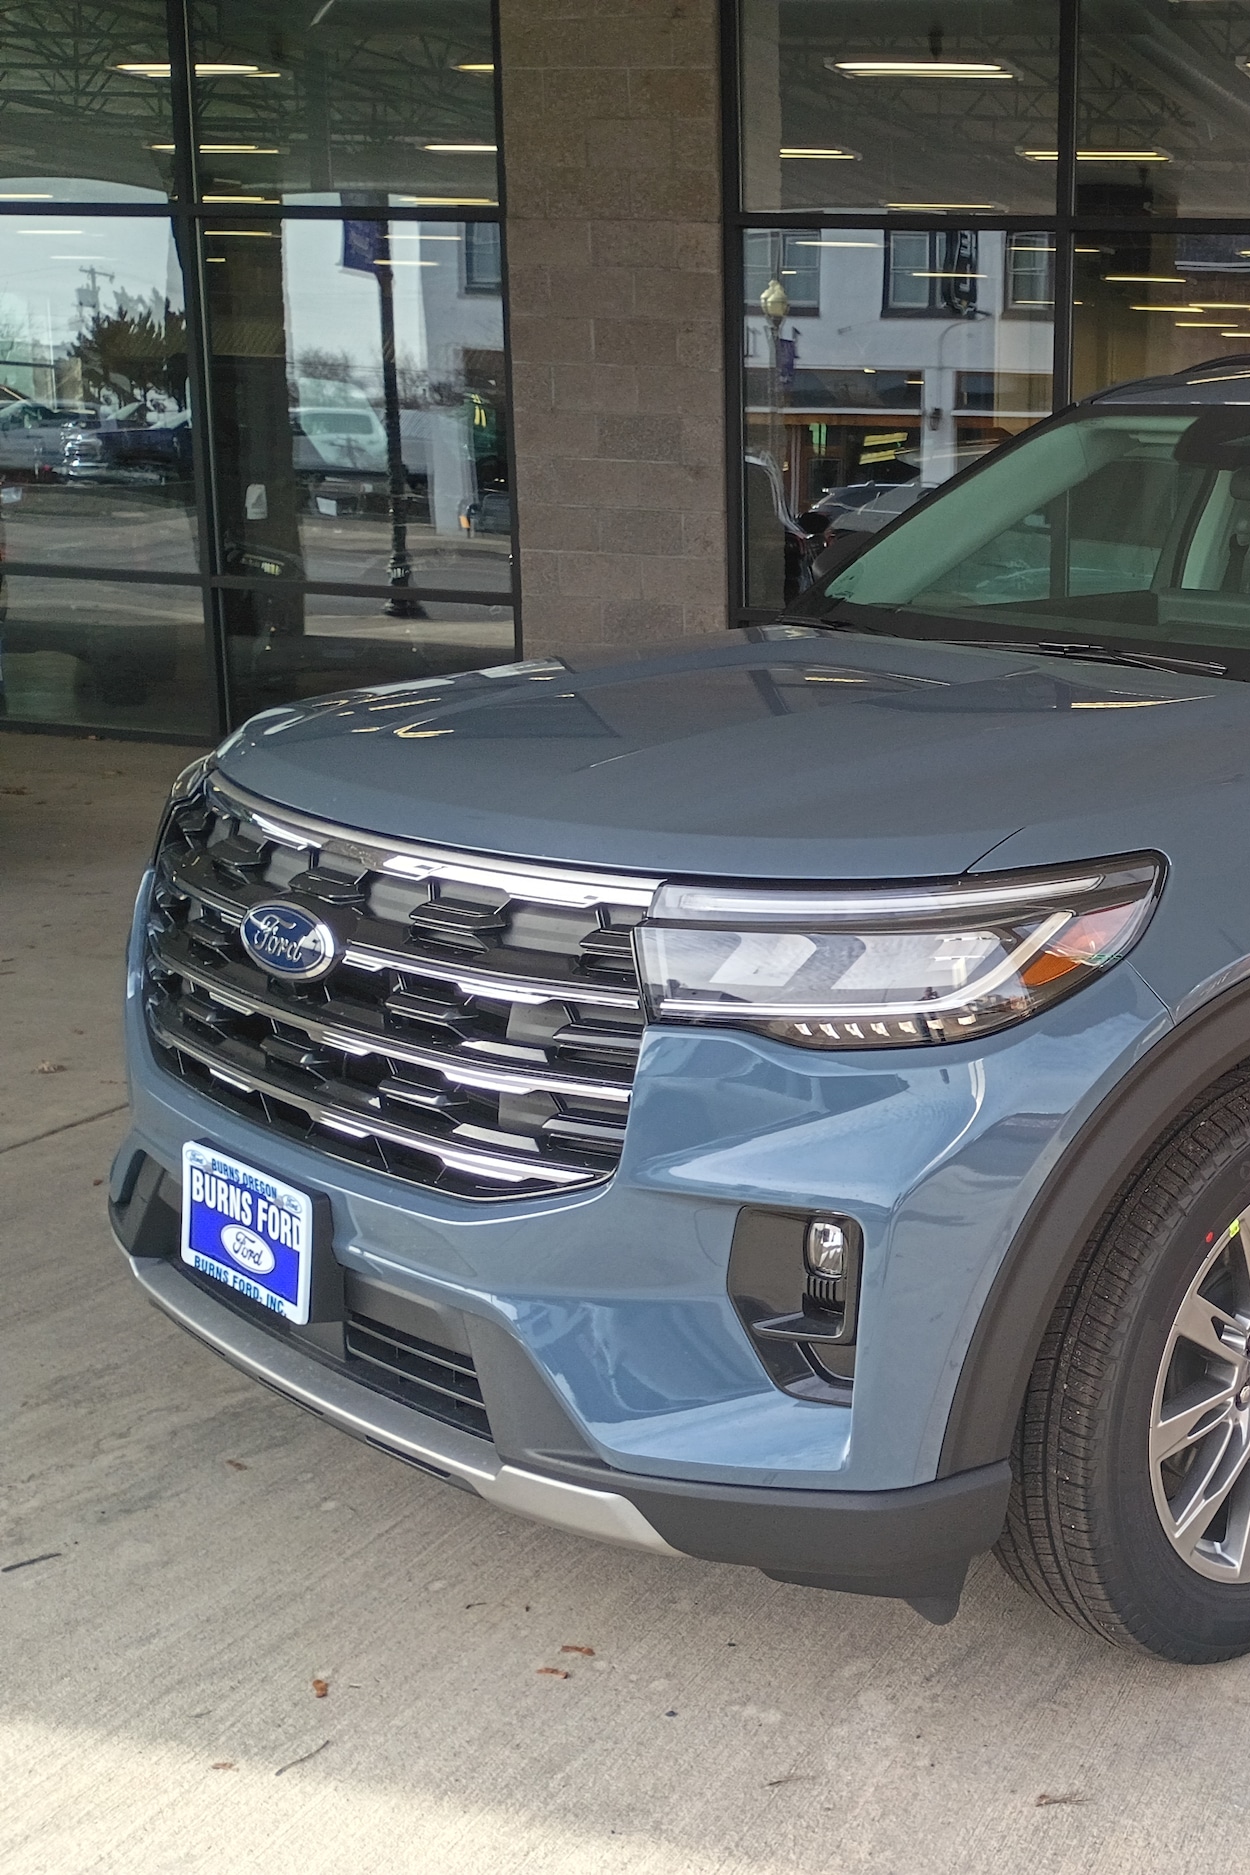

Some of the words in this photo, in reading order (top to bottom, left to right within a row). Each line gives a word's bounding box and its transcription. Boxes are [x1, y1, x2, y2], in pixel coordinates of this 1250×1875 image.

[253, 913, 305, 962] Ford
[211, 1158, 240, 1183] BURNS
[242, 1172, 277, 1199] OREGON
[192, 1168, 252, 1227] BURNS
[257, 1197, 301, 1252] FORD
[231, 1230, 264, 1266] Ford
[194, 1255, 230, 1284] BURNS
